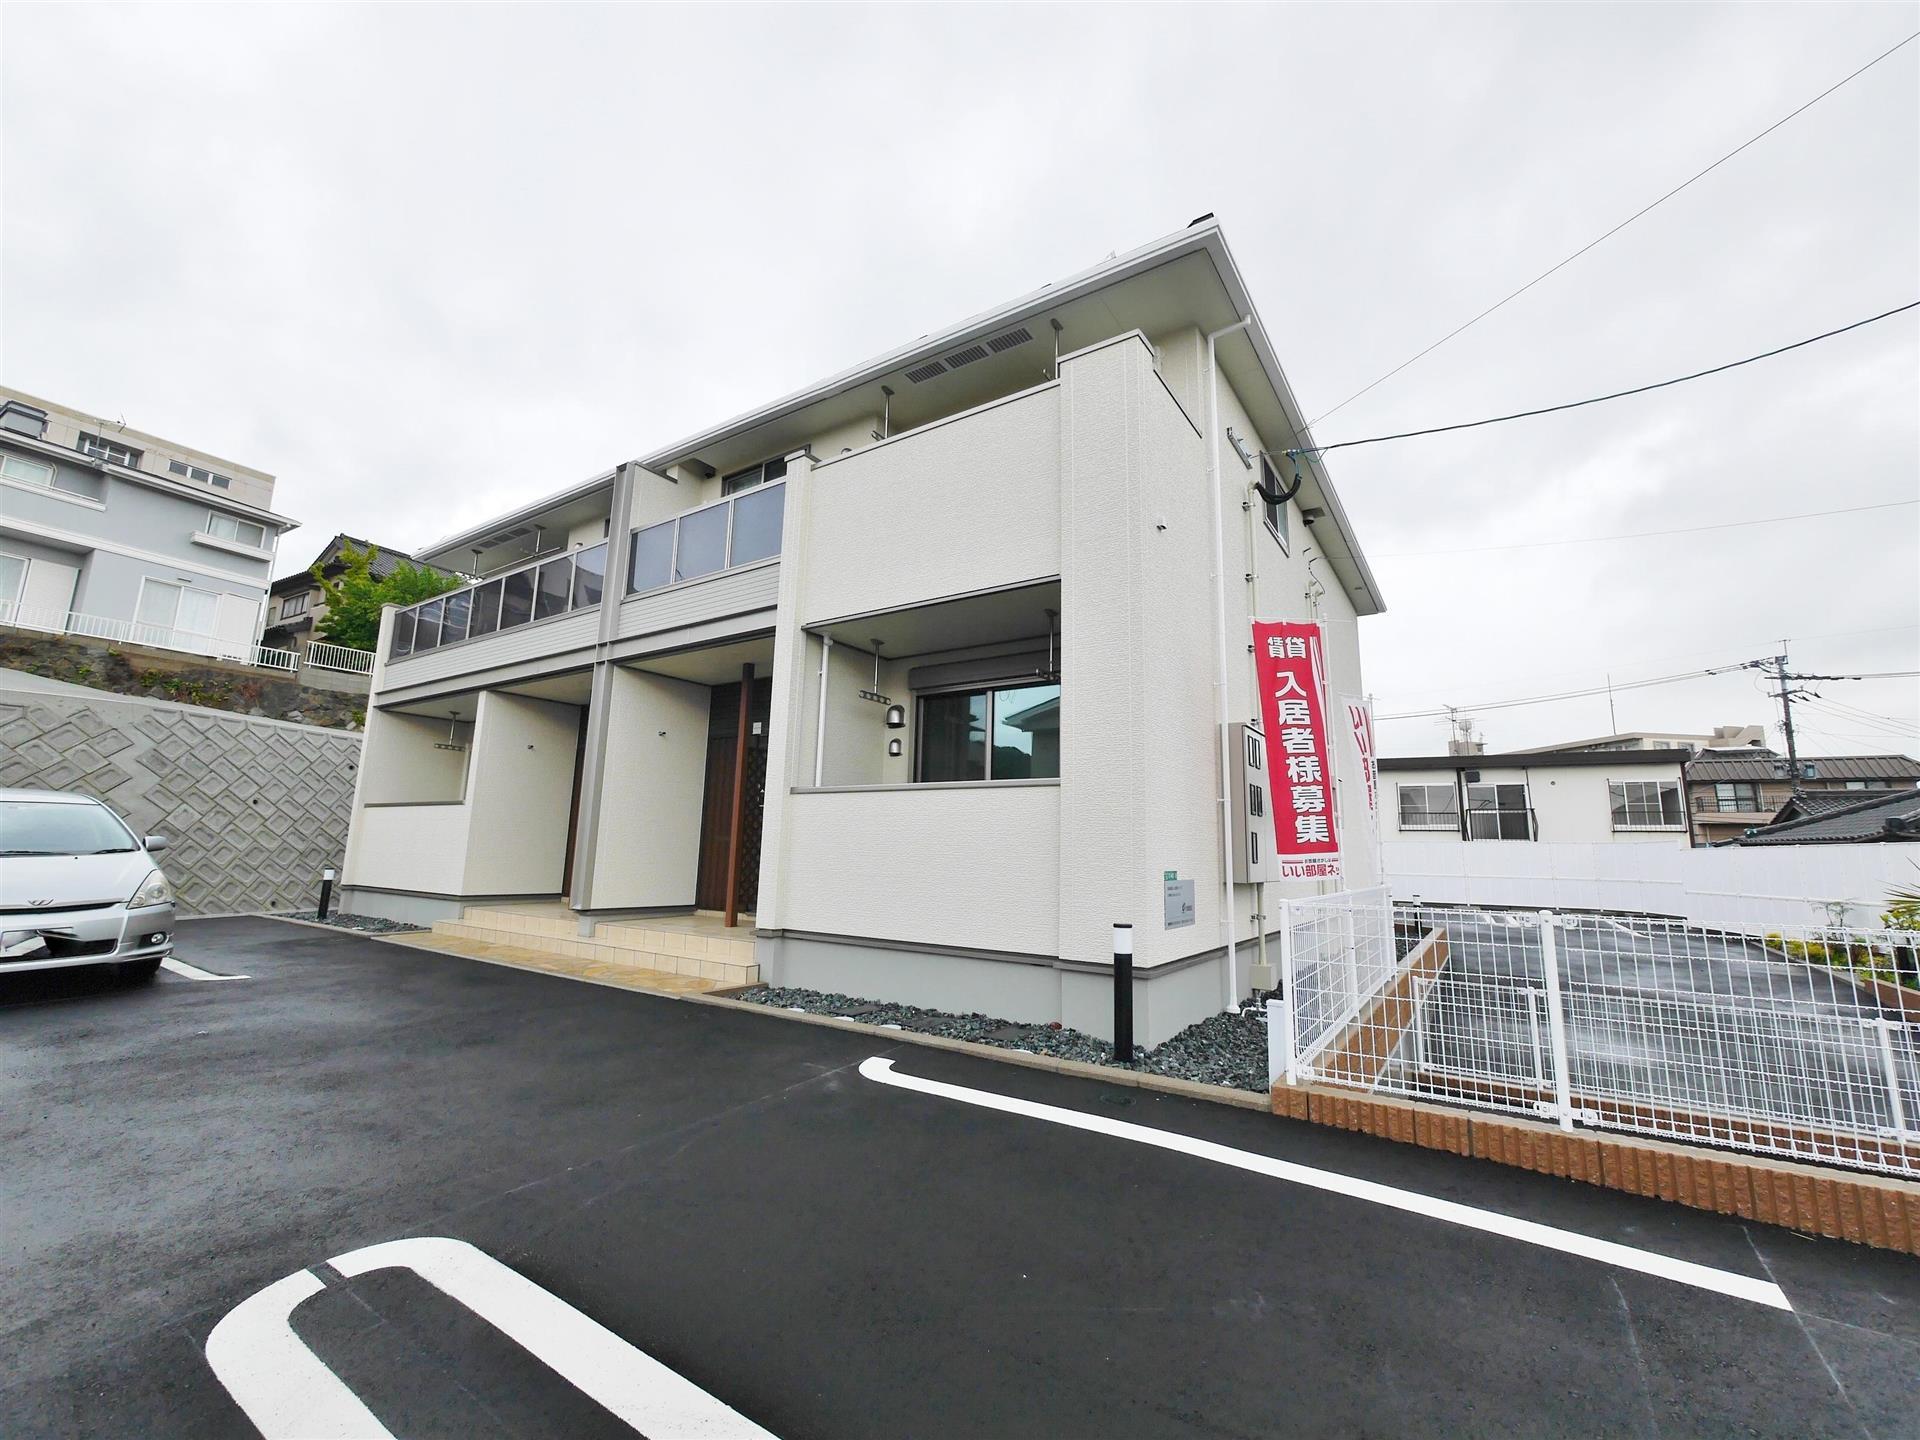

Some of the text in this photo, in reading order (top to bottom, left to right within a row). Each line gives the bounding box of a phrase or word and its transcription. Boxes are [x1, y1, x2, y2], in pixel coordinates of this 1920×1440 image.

[1267, 636, 1307, 659] 賃貸
[1274, 671, 1330, 844] 入居者様募集
